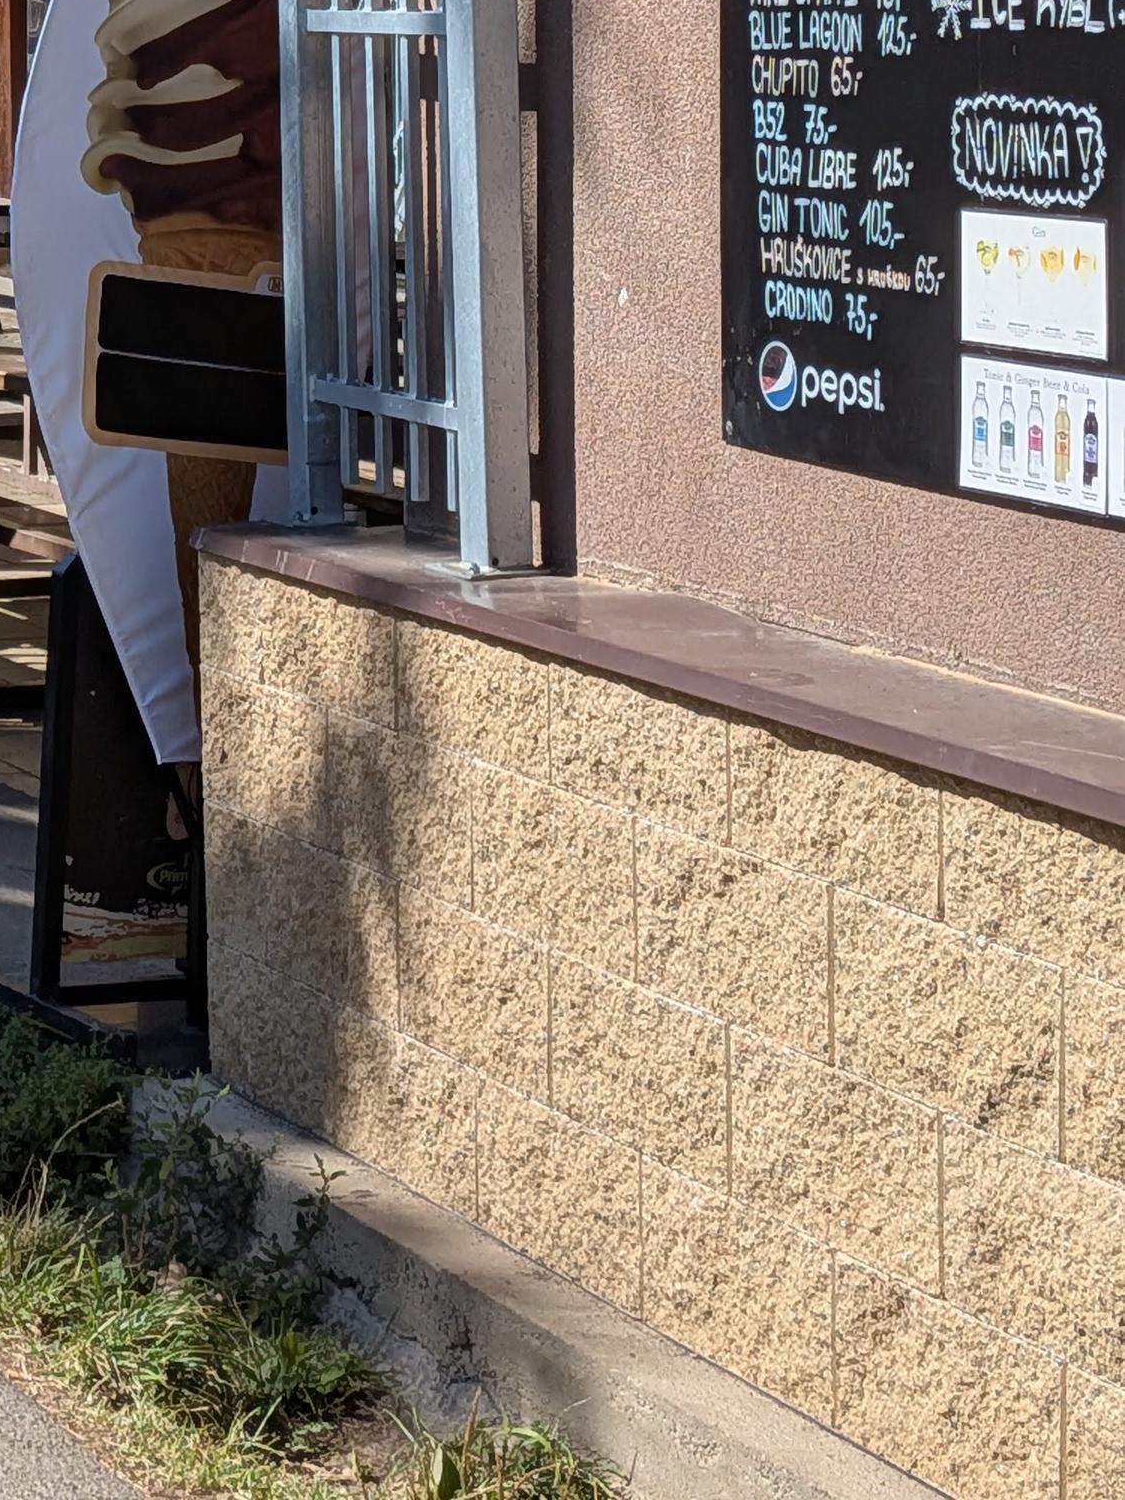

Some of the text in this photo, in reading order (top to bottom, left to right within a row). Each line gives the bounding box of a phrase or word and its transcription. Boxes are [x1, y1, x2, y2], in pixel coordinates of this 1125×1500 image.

[748, 9, 793, 51] BLUE
[798, 9, 863, 54] LAGOON
[751, 53, 820, 99] CHUPITO
[752, 98, 788, 142] B52
[755, 142, 803, 187] CUBA
[807, 147, 858, 191] LIBRE
[965, 117, 1070, 181] NOVINKA
[757, 188, 789, 234] GIN
[793, 196, 850, 241] TONIC
[760, 234, 852, 285] HRUŠKOVICE
[764, 279, 833, 324] CRODINO
[801, 364, 883, 415] pepsi
